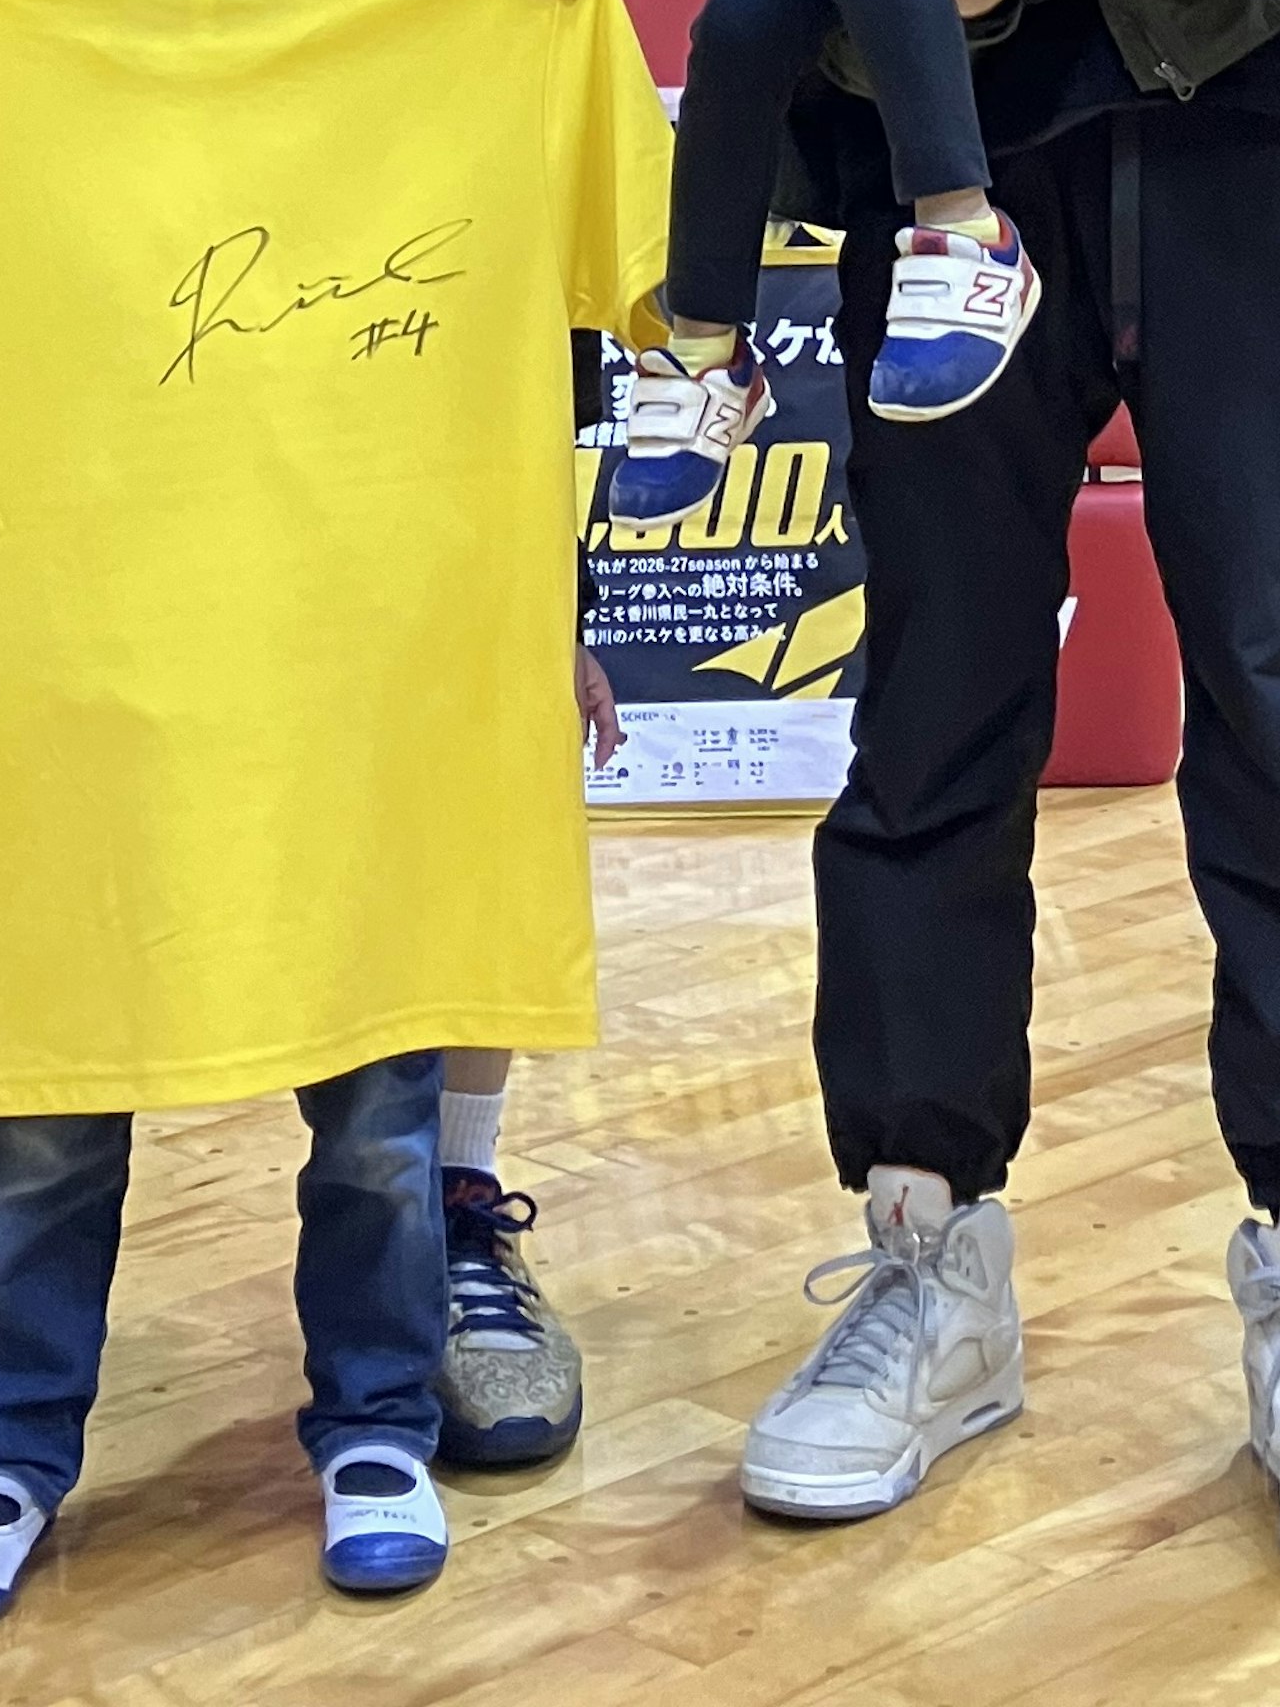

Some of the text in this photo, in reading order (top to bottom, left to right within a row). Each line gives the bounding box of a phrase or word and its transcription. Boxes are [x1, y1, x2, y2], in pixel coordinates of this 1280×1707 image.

[349, 308, 440, 361] #4
[744, 552, 819, 571] から始まる
